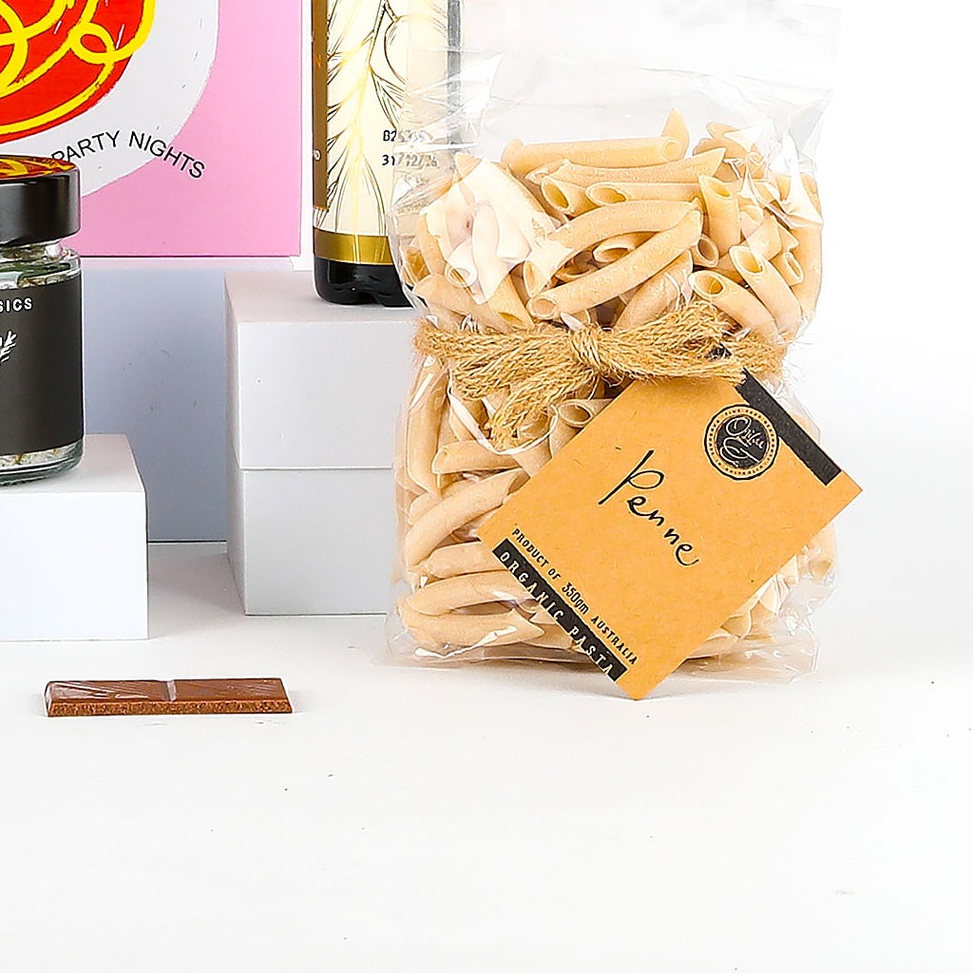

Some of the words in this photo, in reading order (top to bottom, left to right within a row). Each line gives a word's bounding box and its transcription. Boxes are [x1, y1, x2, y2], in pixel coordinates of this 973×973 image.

[129, 131, 205, 178] NIGHTS
[597, 449, 700, 567] Penne
[499, 551, 564, 621] ORGANIC
[569, 625, 612, 674] PASTA
[512, 528, 549, 568] PRODUCT
[547, 568, 561, 580] OF
[561, 582, 590, 615] 350gm
[591, 615, 638, 665] AUSTRALIA
